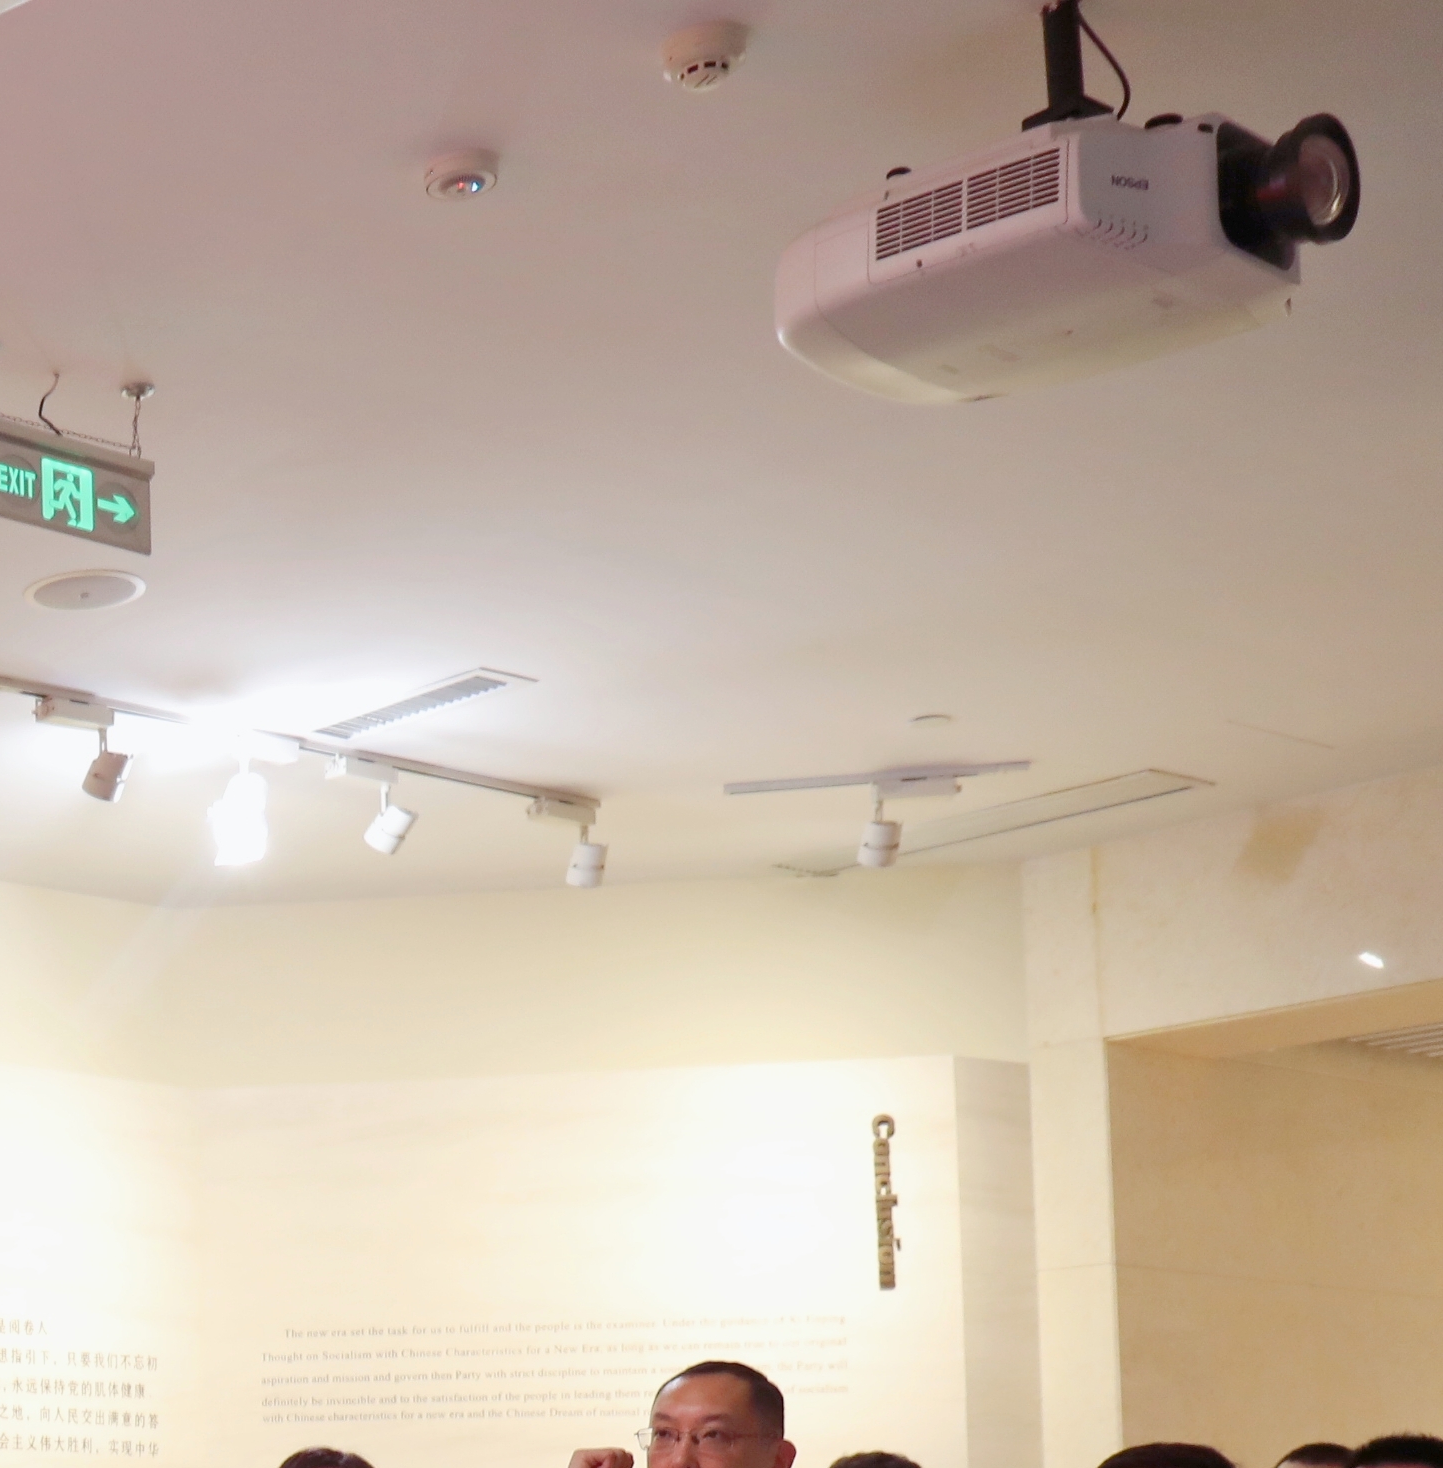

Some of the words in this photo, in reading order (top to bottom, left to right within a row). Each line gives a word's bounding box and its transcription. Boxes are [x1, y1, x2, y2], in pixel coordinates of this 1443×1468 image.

[1111, 174, 1149, 191] EPSON
[872, 1113, 902, 1291] Conclusion
[284, 1329, 303, 1339] The
[306, 1329, 328, 1338] new
[331, 1329, 347, 1337] era
[350, 1328, 365, 1337] set
[368, 1327, 384, 1336] the
[387, 1325, 408, 1336] task
[412, 1325, 426, 1335] for
[430, 1327, 442, 1335] us
[445, 1325, 455, 1334] to
[459, 1323, 489, 1334] fulfill
[493, 1323, 512, 1333] and
[515, 1322, 531, 1332] the
[534, 1321, 570, 1336] people
[573, 1321, 582, 1330] is
[586, 1320, 602, 1330] the
[262, 1352, 303, 1364] Thought
[306, 1353, 319, 1361] on
[322, 1350, 372, 1361] Socialism
[375, 1349, 398, 1359] with
[401, 1349, 442, 1358] Chinese
[445, 1347, 523, 1357] Characteristics
[526, 1346, 541, 1355] for
[554, 1344, 578, 1354] New
[607, 1345, 617, 1353] as
[621, 1343, 645, 1354] long
[648, 1344, 659, 1352] as
[663, 1343, 678, 1351] we
[681, 1343, 700, 1351] can
[261, 1375, 309, 1387] aspiration
[311, 1374, 329, 1384] and
[332, 1374, 370, 1383] mission
[373, 1373, 391, 1382] and
[394, 1373, 428, 1383] govern
[430, 1371, 452, 1381] then
[455, 1370, 481, 1381] Party
[484, 1369, 508, 1379] with
[509, 1369, 535, 1378] strict
[537, 1367, 586, 1379] discipline
[590, 1367, 600, 1376] to
[603, 1366, 648, 1376] maintain
[261, 1396, 308, 1407] definitely
[311, 1396, 323, 1406] be
[326, 1396, 376, 1405] invincible
[378, 1395, 397, 1404] and
[400, 1395, 410, 1403] to
[412, 1393, 427, 1403] the
[430, 1392, 488, 1403] satisfaction
[491, 1391, 502, 1401] of
[505, 1391, 520, 1401] the
[523, 1390, 558, 1402] people
[561, 1391, 571, 1399] in
[573, 1390, 611, 1401] leading
[614, 1389, 640, 1398] them
[262, 1414, 284, 1424] with
[286, 1413, 325, 1423] Chinese
[328, 1412, 398, 1422] characteristics
[400, 1411, 414, 1420] for
[449, 1411, 465, 1419] era
[467, 1409, 485, 1418] and
[488, 1408, 503, 1418] the
[506, 1408, 546, 1418] Chinese
[549, 1408, 586, 1417] Dream
[586, 1408, 597, 1417] of
[599, 1408, 640, 1417] national
